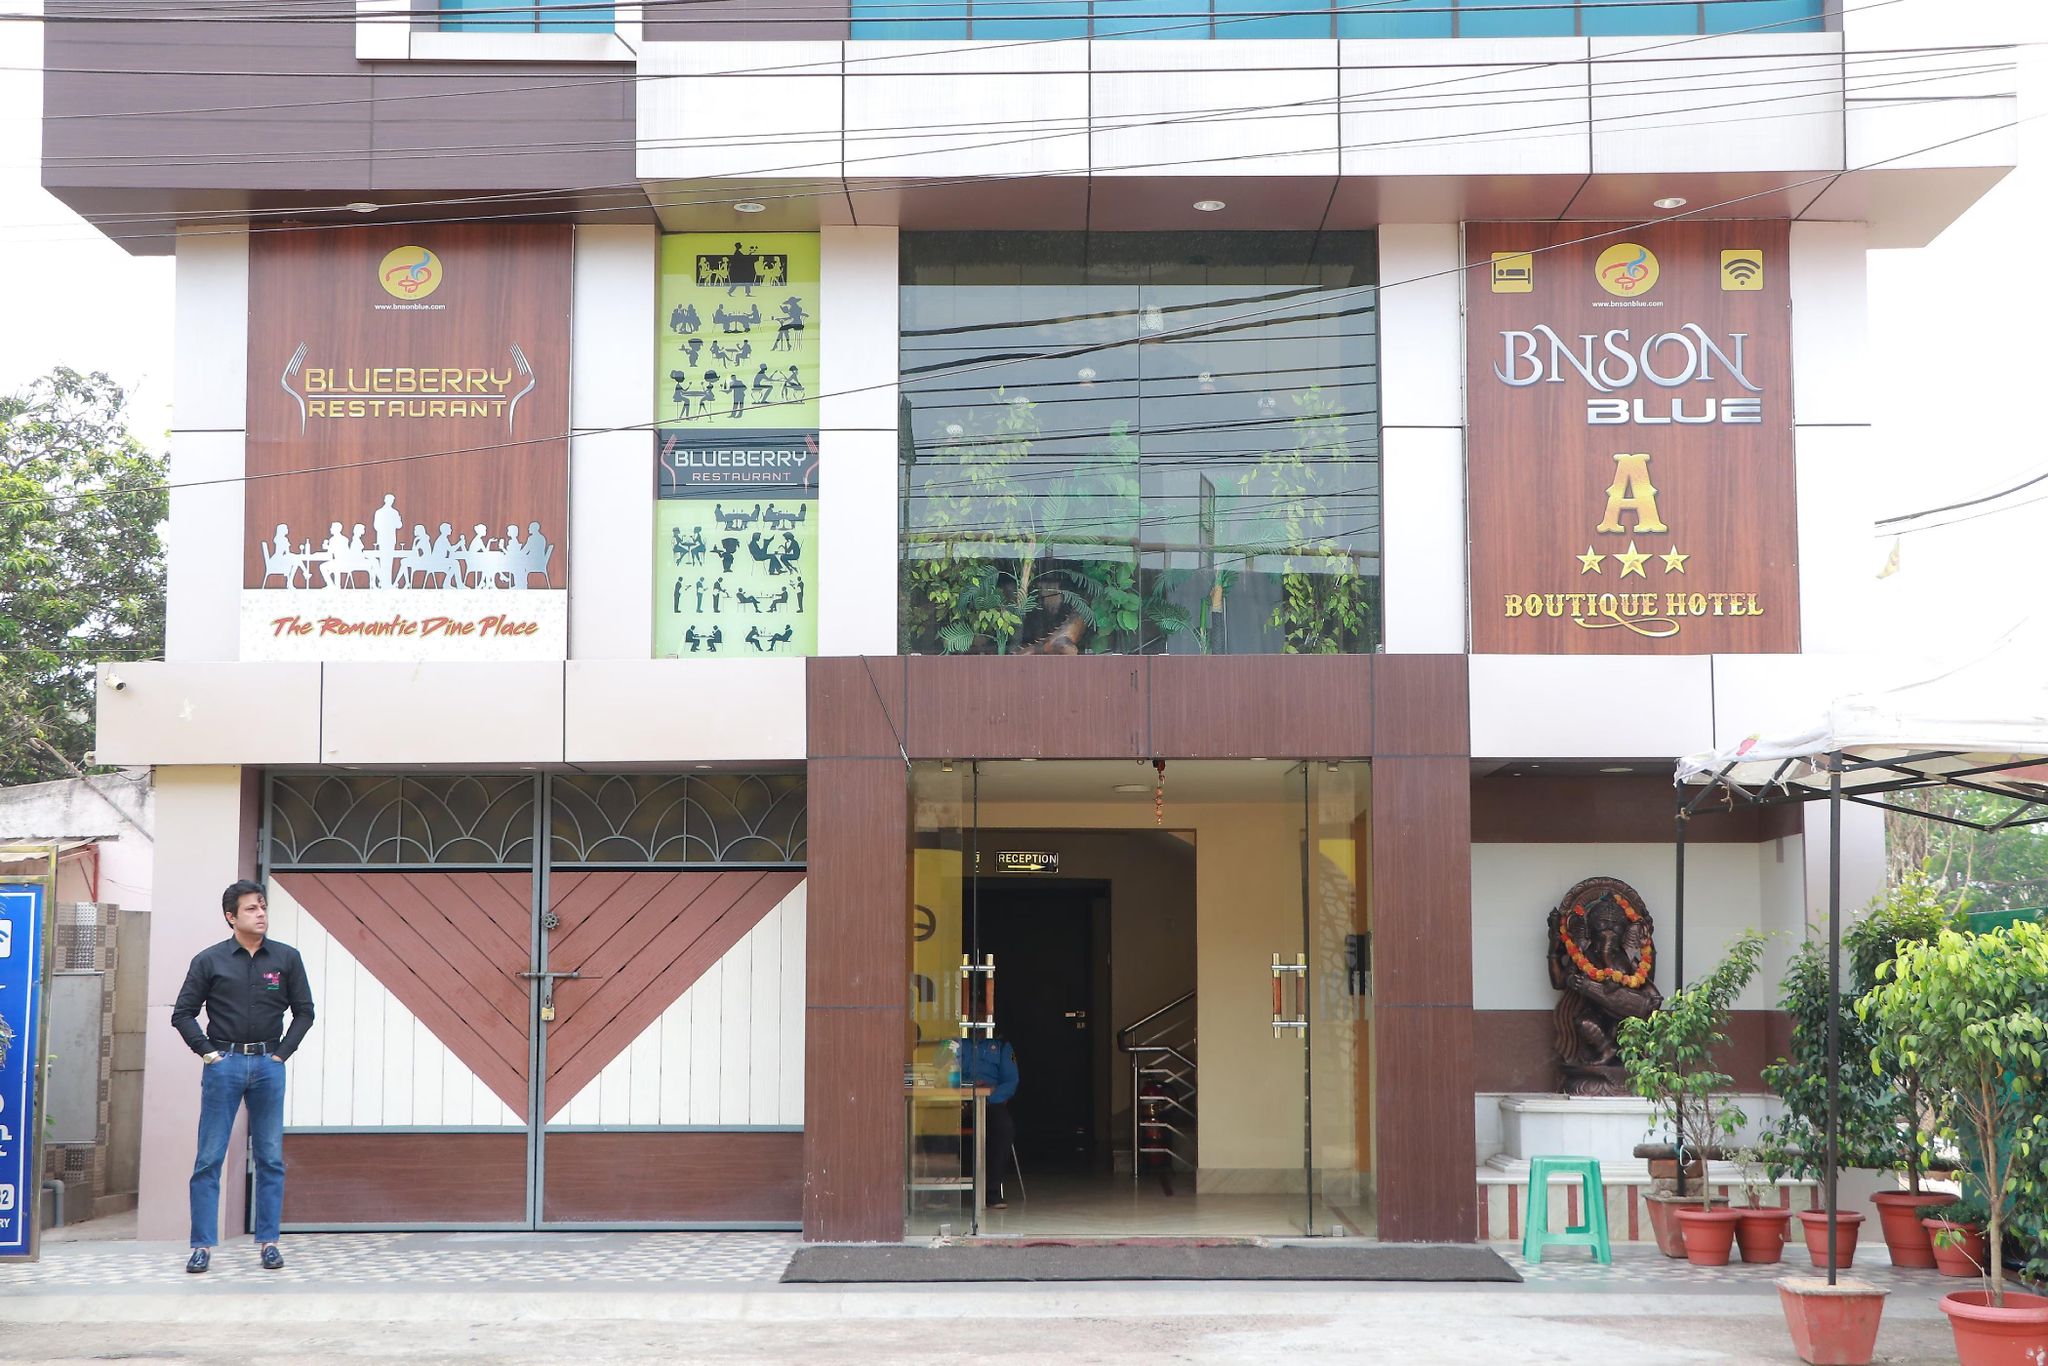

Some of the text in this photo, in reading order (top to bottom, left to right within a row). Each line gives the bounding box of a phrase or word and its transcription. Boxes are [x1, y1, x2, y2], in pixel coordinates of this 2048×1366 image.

[1592, 300, 1664, 308] www.bnsonblue.com
[1493, 323, 1763, 392] BNSON
[305, 368, 512, 393] BLUEBERRY
[308, 400, 507, 418] RESTAURANT
[1587, 397, 1762, 424] BLUE
[674, 450, 807, 467] BLUEBERRY
[692, 472, 791, 481] RESTAURANT
[1596, 453, 1668, 533] A
[1666, 593, 1764, 616] HOTEL
[272, 614, 539, 638] The Romantic Dine Place
[998, 854, 1057, 864] RECEPTION
